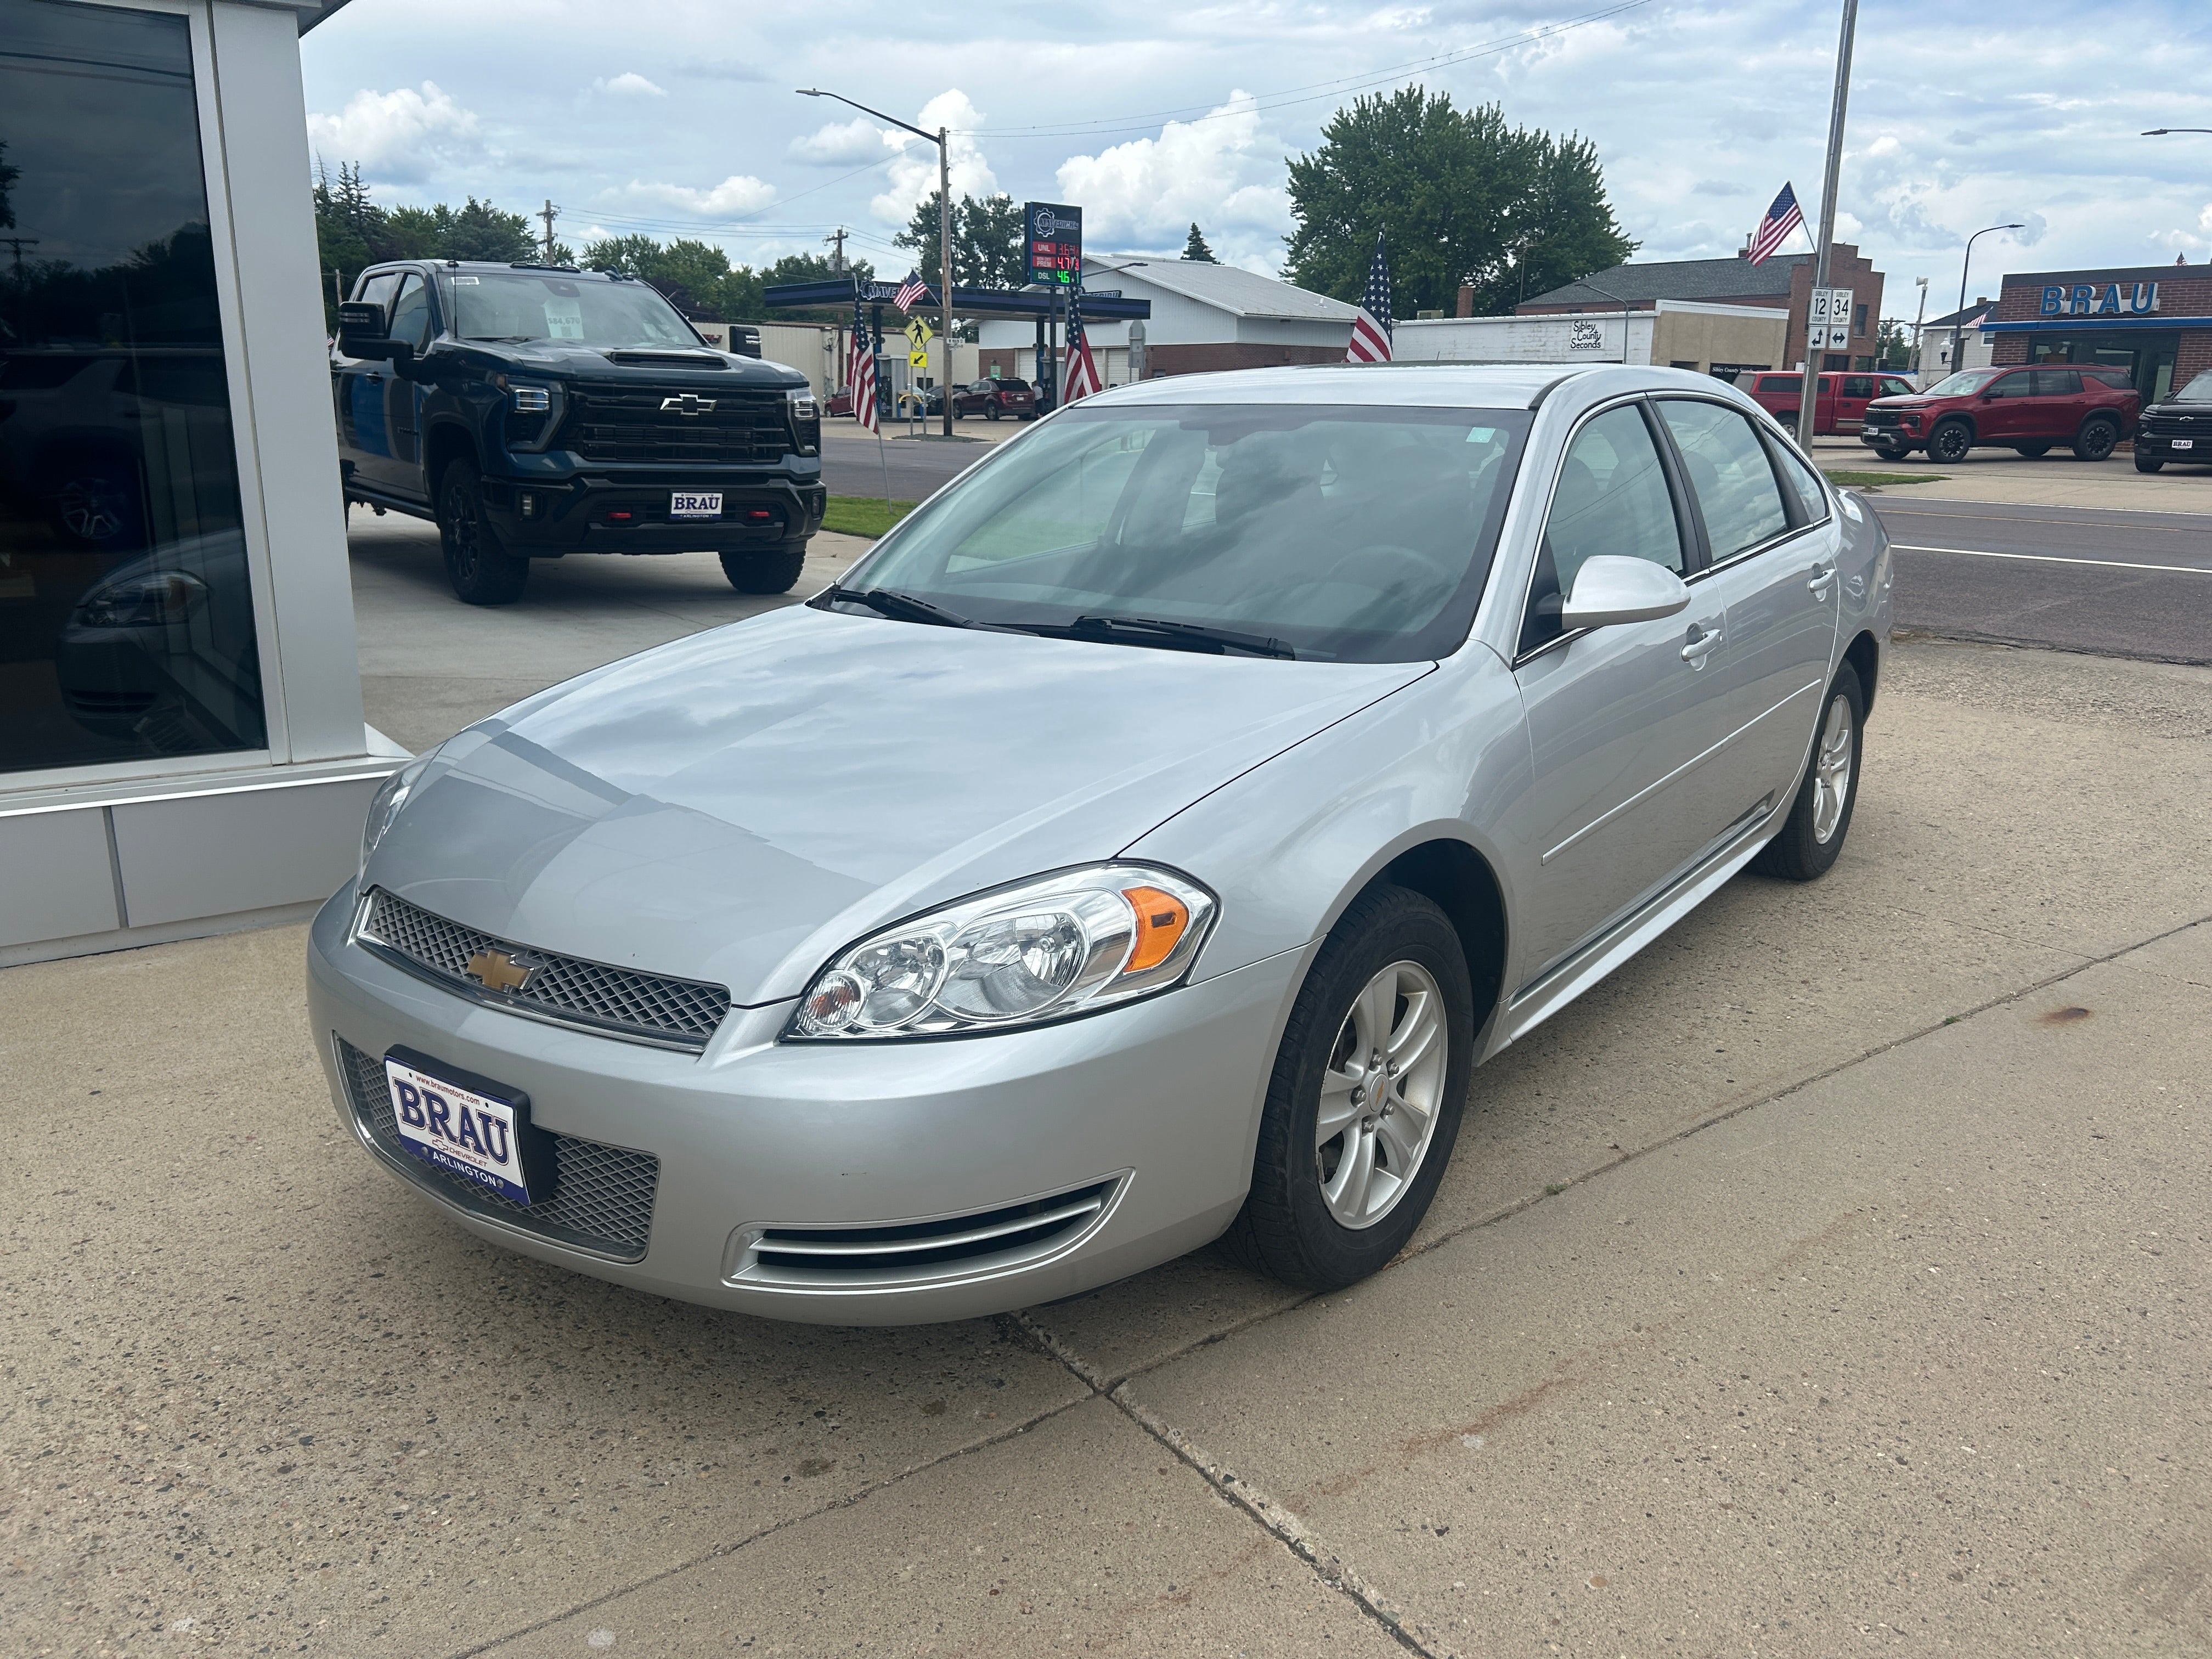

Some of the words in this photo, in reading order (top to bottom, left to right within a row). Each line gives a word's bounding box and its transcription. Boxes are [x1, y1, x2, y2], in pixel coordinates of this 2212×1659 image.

[1037, 244, 1051, 252] UNL
[1037, 272, 1051, 280] DSL
[1815, 298, 1826, 315] 12
[1833, 298, 1849, 316] 34
[2040, 282, 2159, 315] BRAU
[1573, 320, 1596, 333] Sibley
[1570, 338, 1601, 349] Seconds
[1577, 329, 1602, 342] County
[674, 496, 720, 510] BRAU
[416, 1075, 481, 1105] www.braumotors.com
[392, 1076, 509, 1166] BRAU
[449, 1147, 488, 1167] CHEVROLET
[433, 1151, 497, 1187] ARLINGTON
